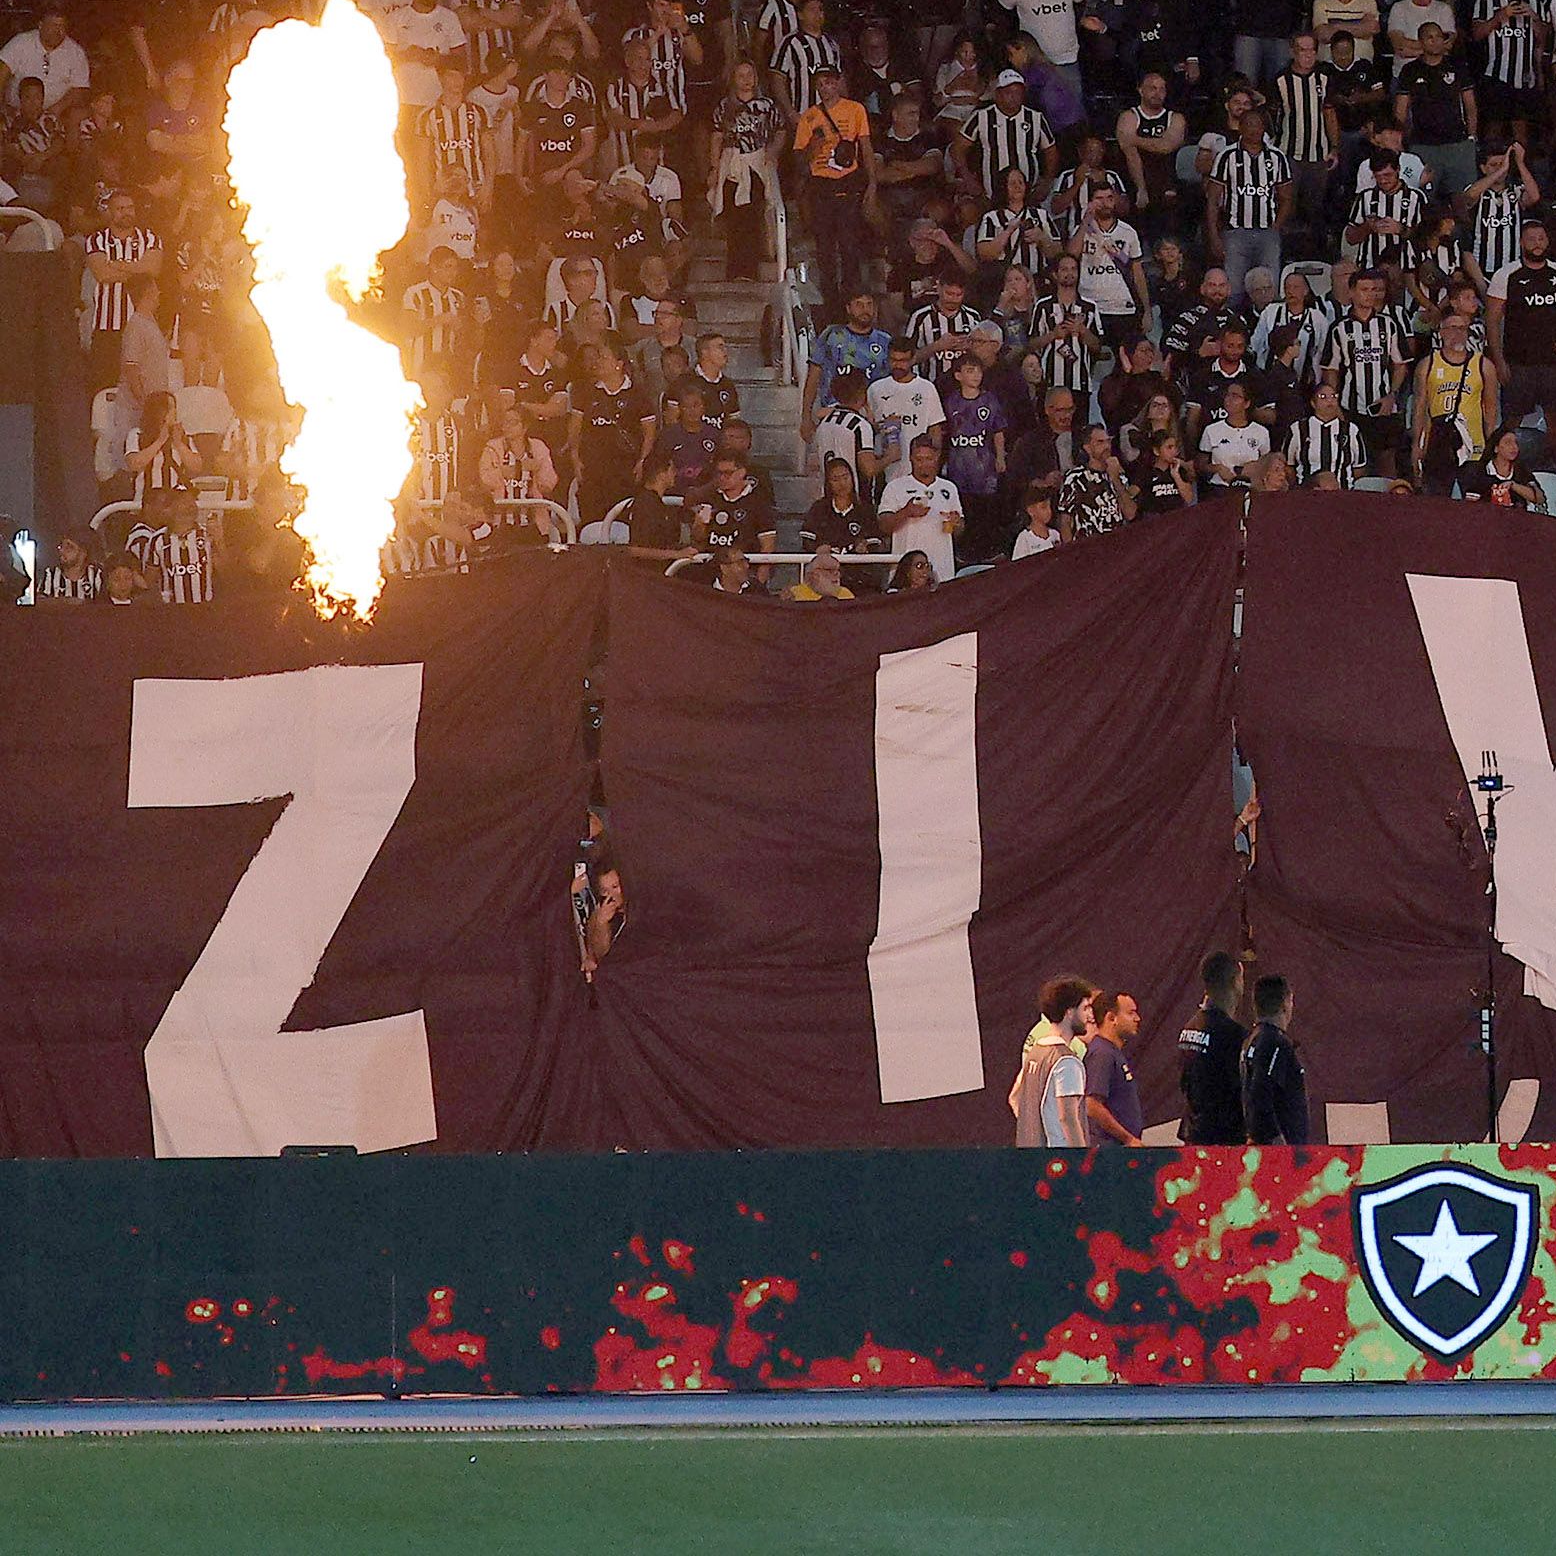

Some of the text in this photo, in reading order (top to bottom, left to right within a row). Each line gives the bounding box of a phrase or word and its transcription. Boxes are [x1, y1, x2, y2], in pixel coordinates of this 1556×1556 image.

[1032, 2, 1066, 13] vbet
[1495, 26, 1526, 37] vbet
[653, 57, 676, 69] bet
[440, 138, 472, 149] vbet
[540, 140, 572, 150] vbet
[1237, 184, 1270, 196] vbet
[1482, 216, 1512, 227] vbet
[564, 229, 593, 239] vbet
[1355, 346, 1382, 354] Golden
[1211, 408, 1227, 418] vb
[951, 434, 984, 447] vbet
[426, 452, 449, 462] bet
[710, 531, 732, 546] bet
[168, 564, 201, 576] vbet
